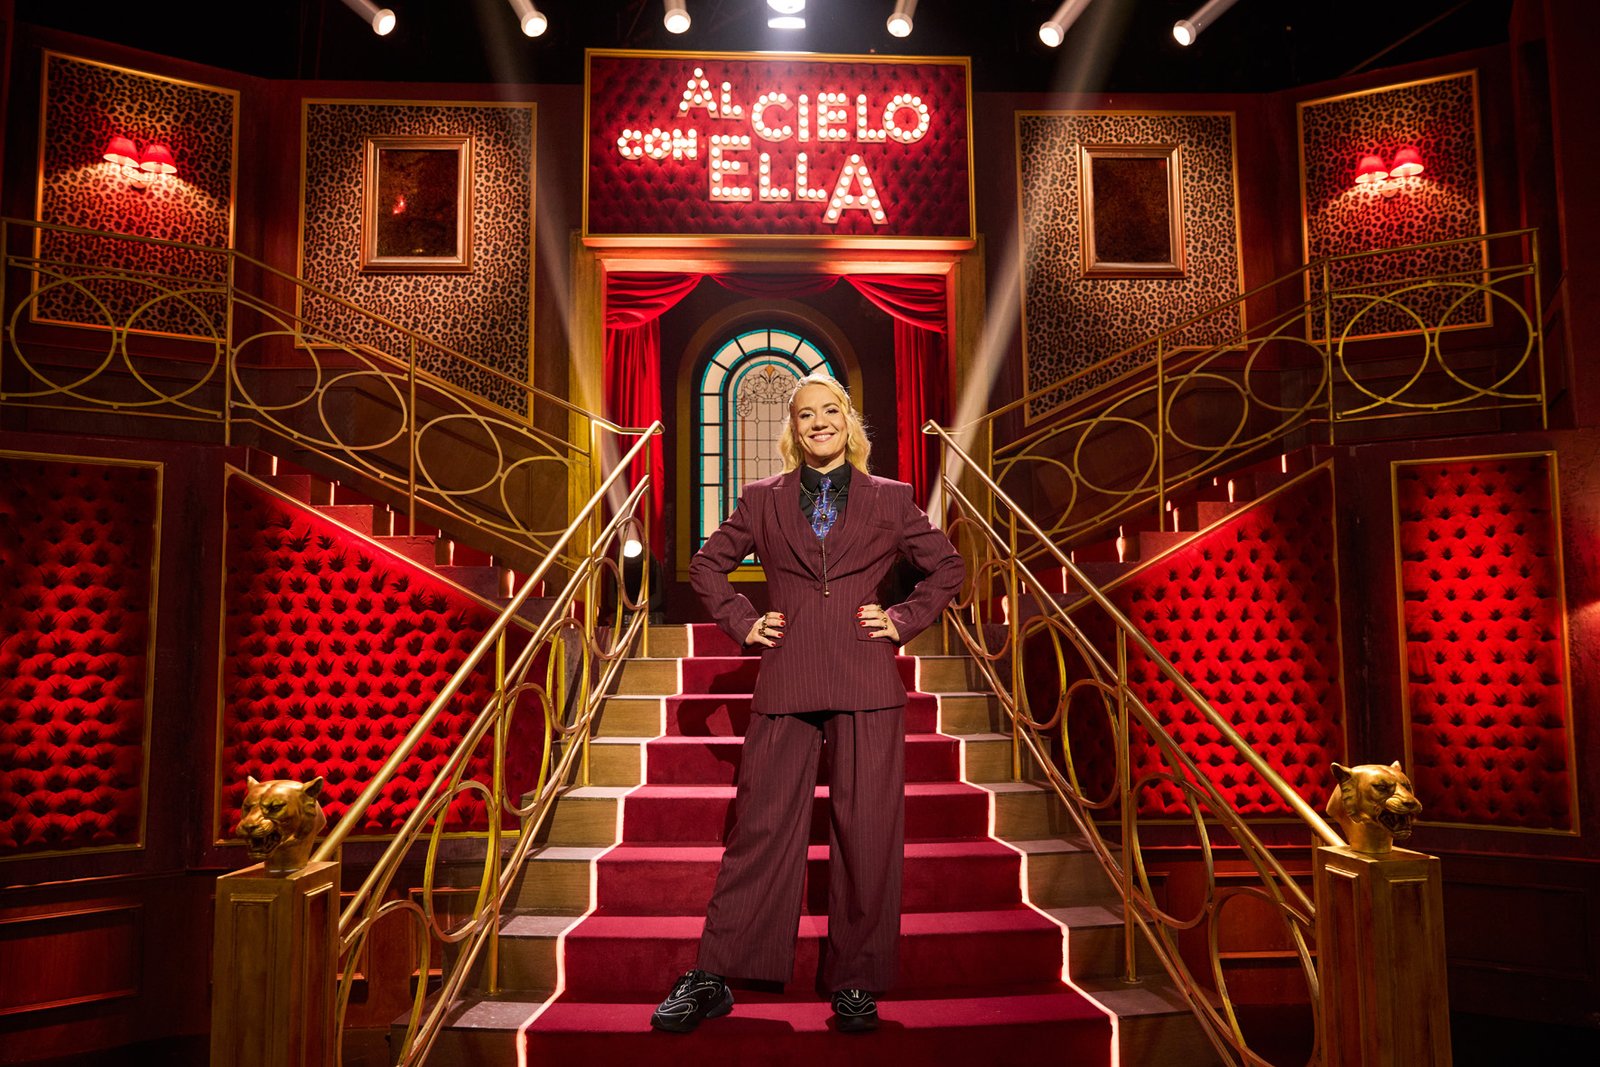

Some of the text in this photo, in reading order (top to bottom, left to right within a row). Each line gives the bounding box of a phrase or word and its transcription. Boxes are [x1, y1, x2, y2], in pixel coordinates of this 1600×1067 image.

[677, 67, 930, 143] AL CIELO
[617, 128, 889, 225] CON ELLA
